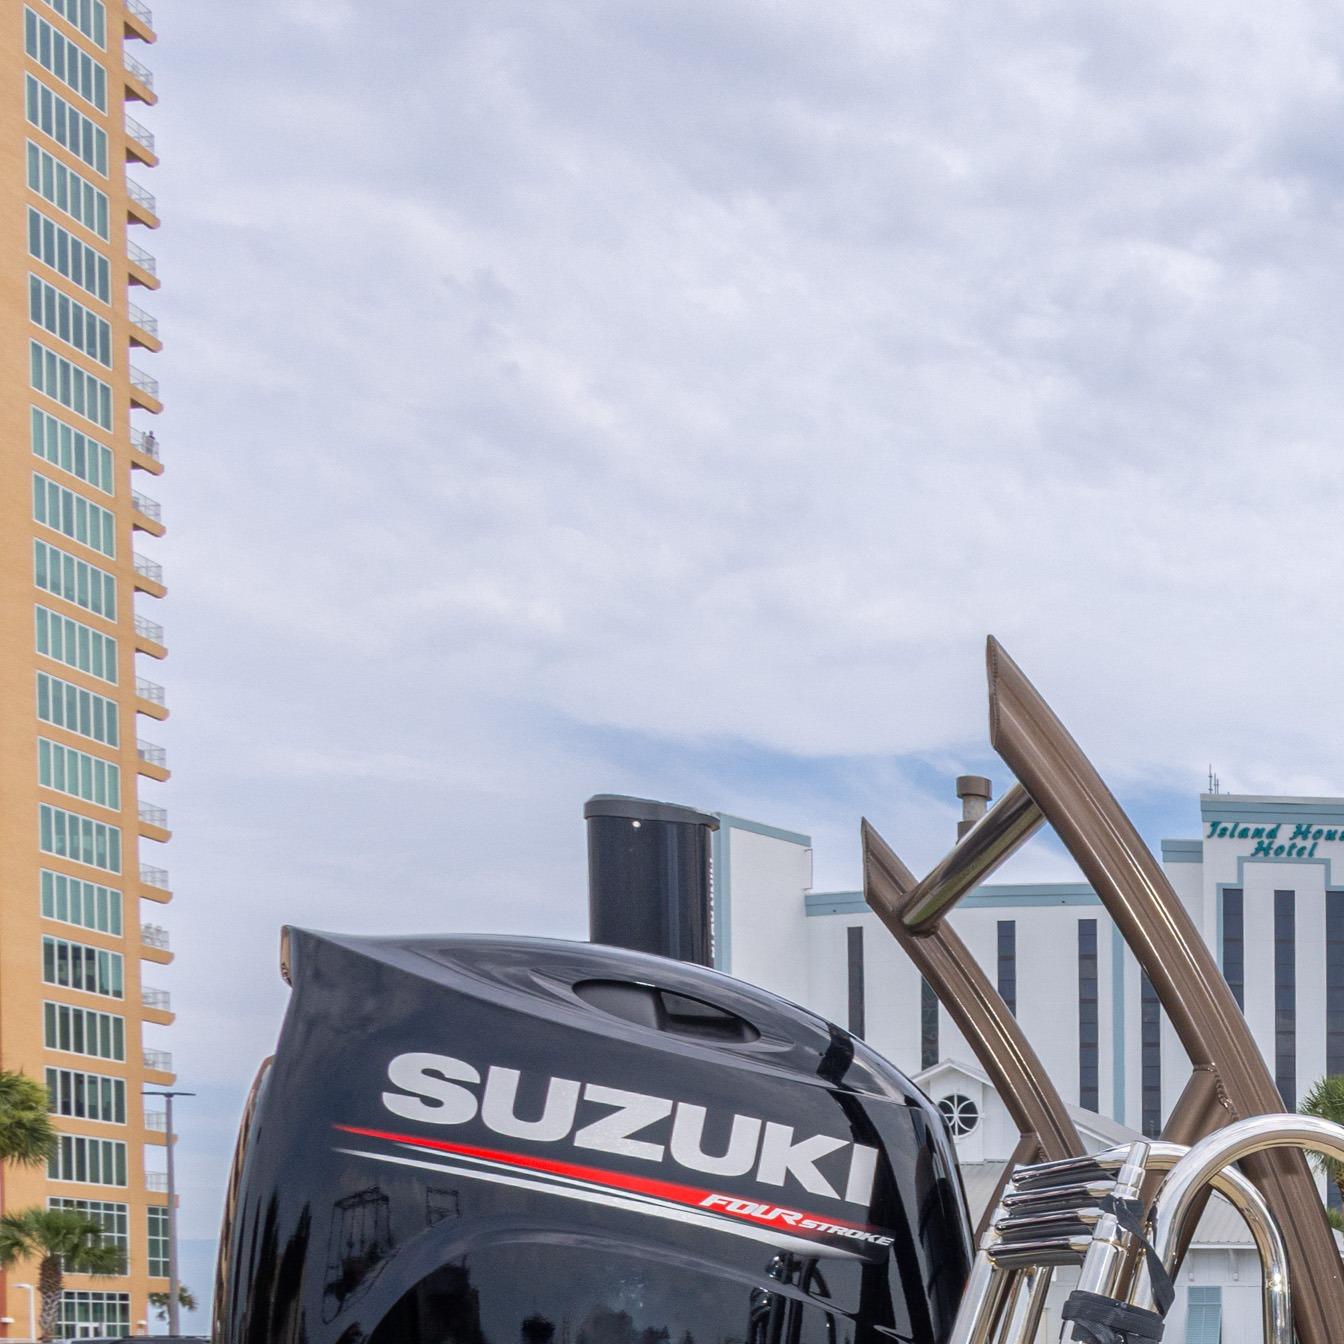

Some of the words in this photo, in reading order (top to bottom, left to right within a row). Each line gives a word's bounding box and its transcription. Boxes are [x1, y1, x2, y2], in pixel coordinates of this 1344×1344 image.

[1207, 821, 1281, 839] Island
[1250, 840, 1319, 858] Hotel
[382, 1052, 879, 1206] SUZUKI
[700, 1193, 803, 1227] FOUR
[800, 1219, 895, 1246] STROKE
